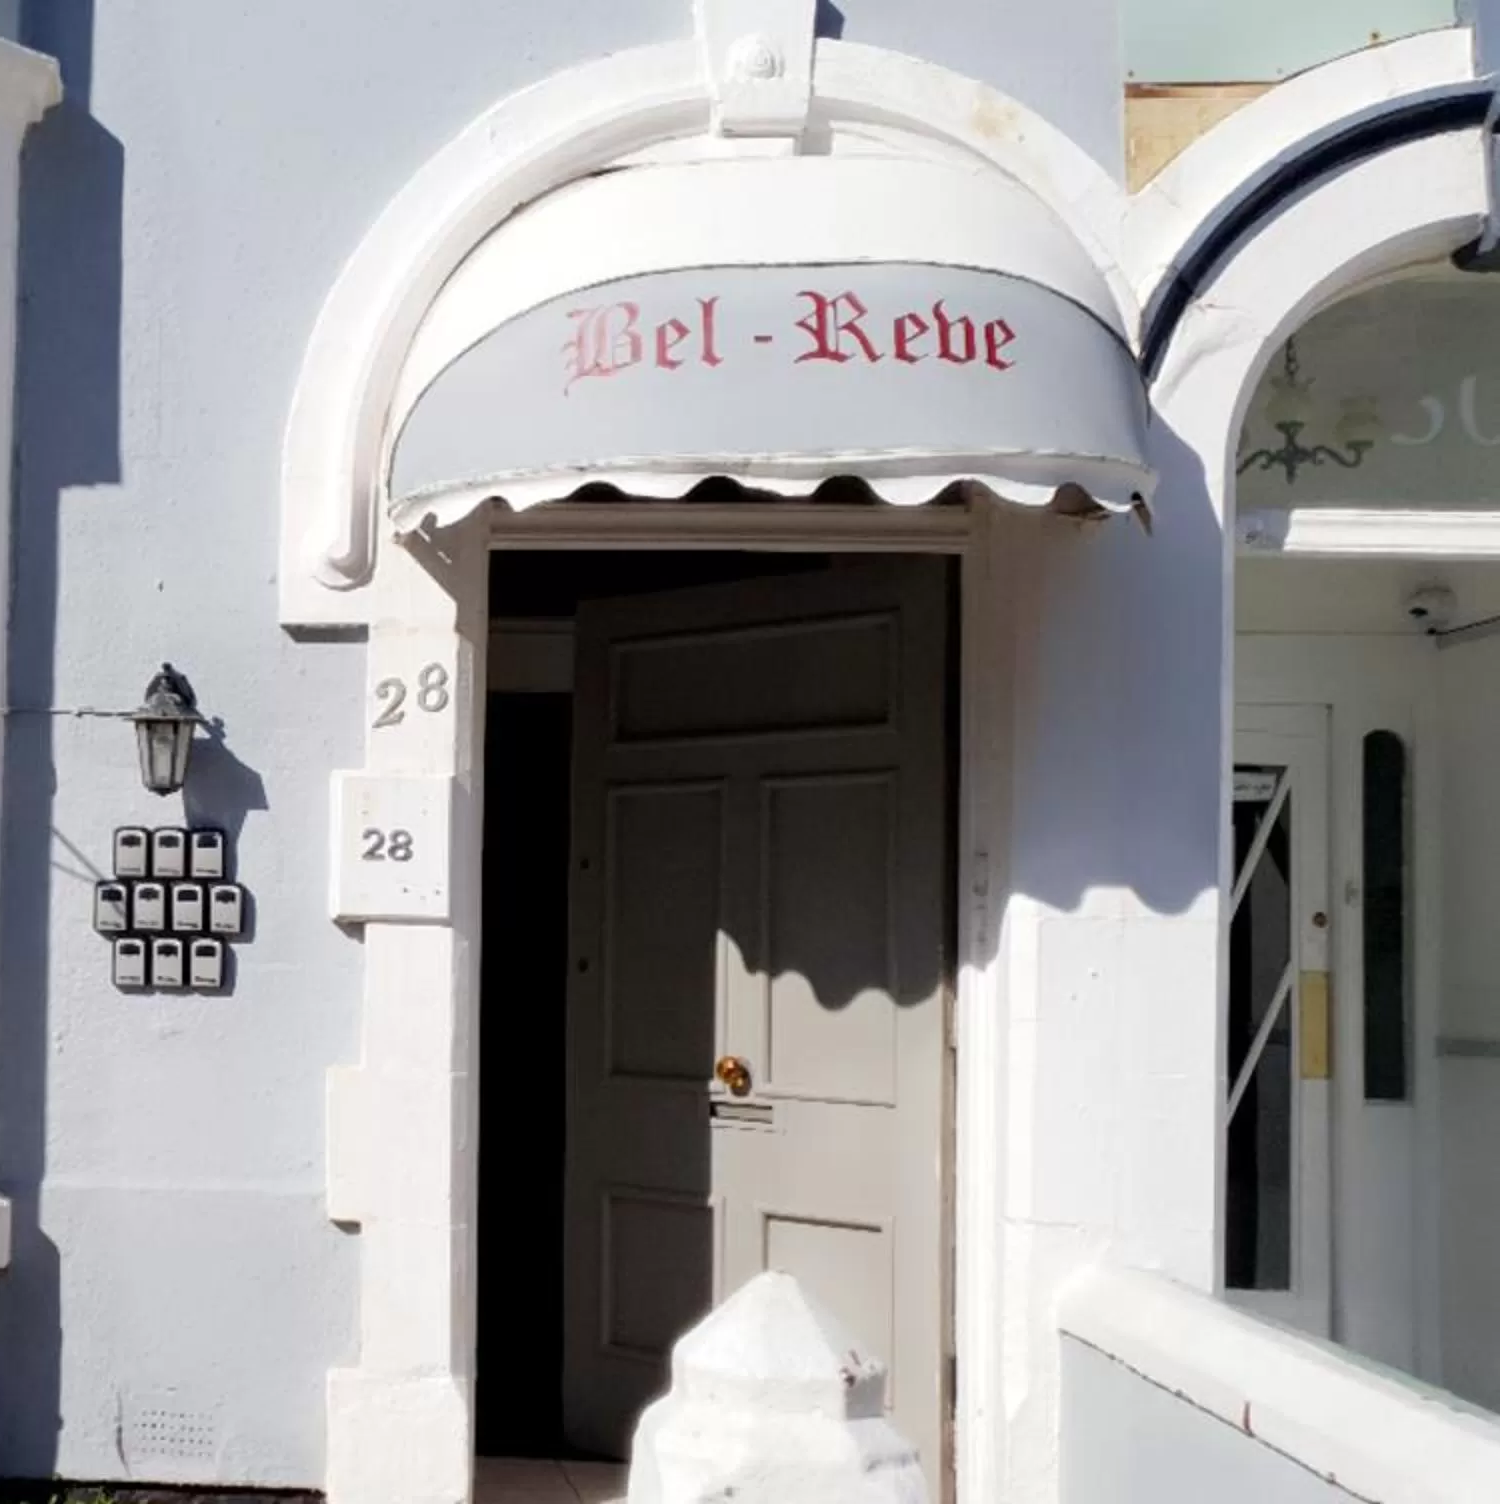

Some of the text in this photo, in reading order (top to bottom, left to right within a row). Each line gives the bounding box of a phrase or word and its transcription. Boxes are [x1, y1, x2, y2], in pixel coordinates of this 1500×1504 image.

[560, 290, 1017, 396] Bel - Reve
[372, 662, 449, 729] 28
[361, 828, 414, 862] 28
